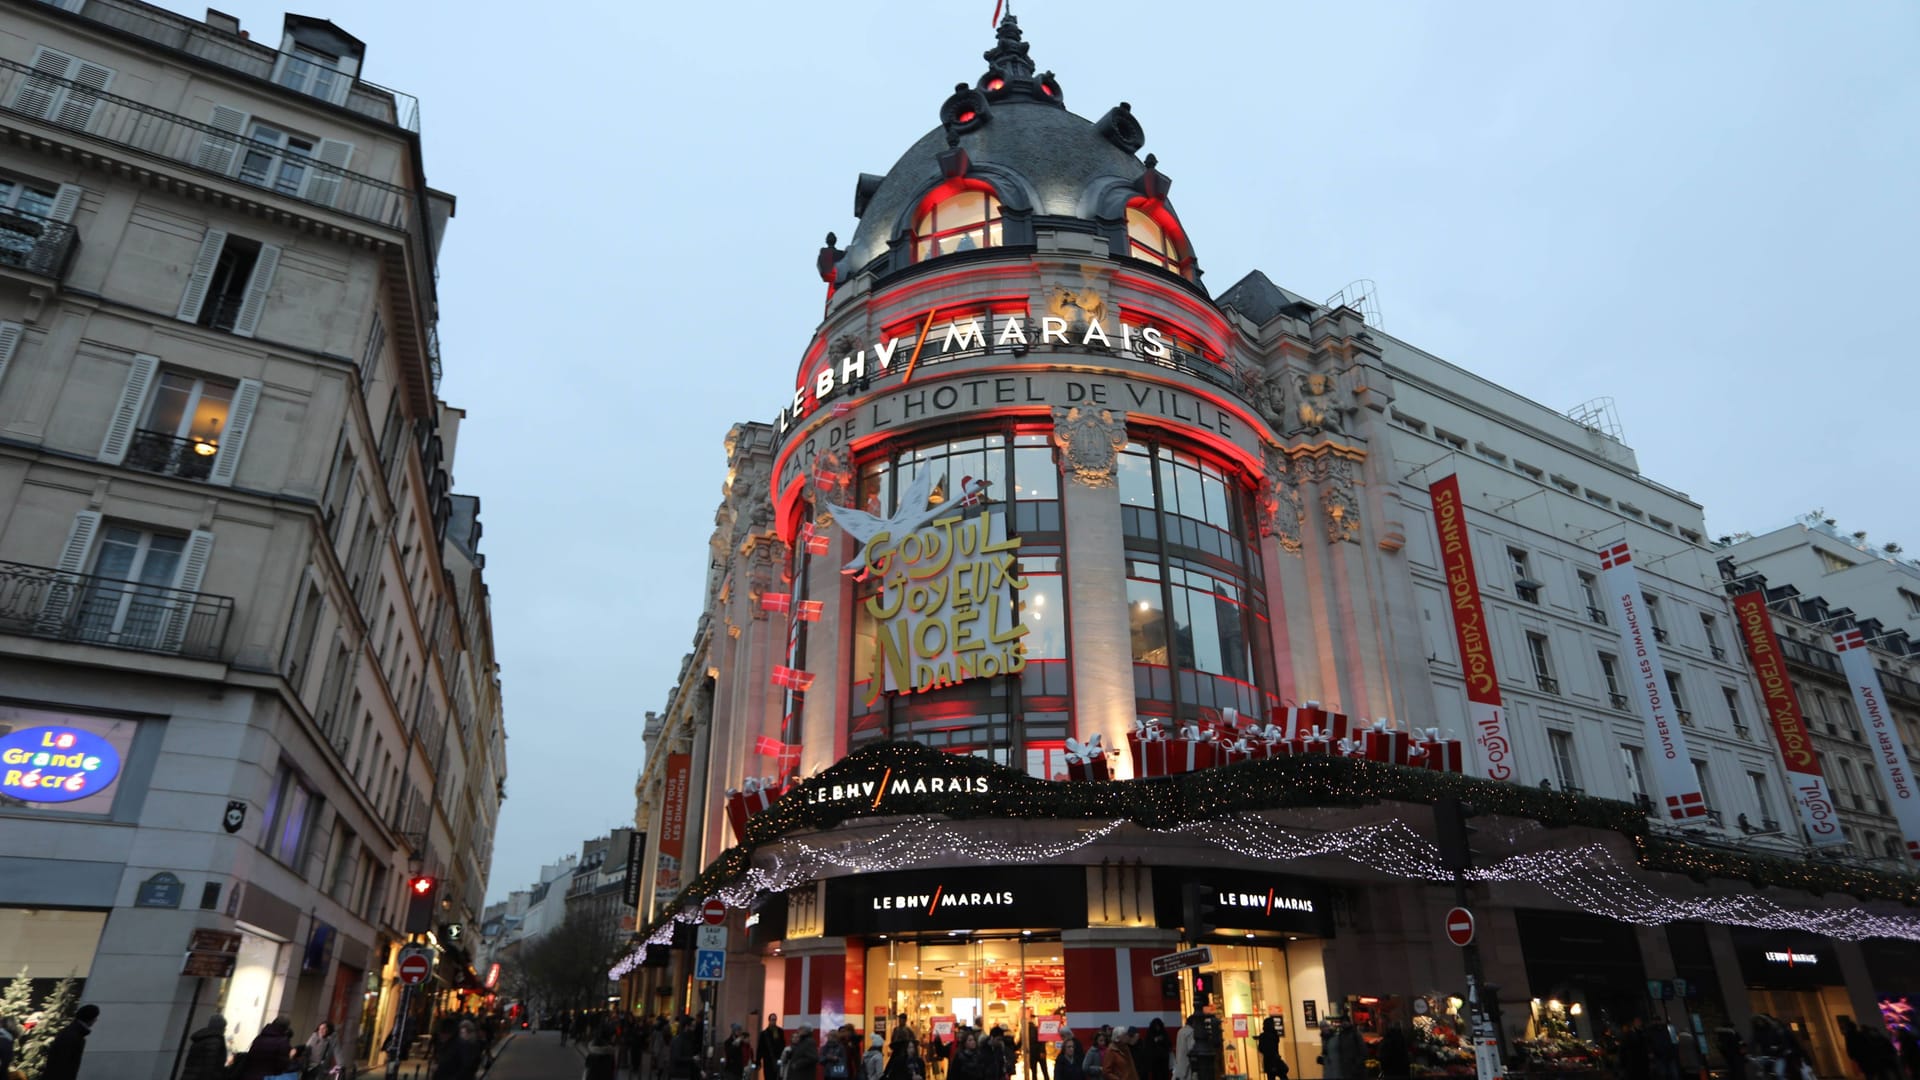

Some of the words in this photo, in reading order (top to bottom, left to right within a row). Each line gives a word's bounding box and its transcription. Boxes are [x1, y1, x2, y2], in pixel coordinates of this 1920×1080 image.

[781, 386, 805, 433] LE
[830, 418, 857, 447] DE
[873, 377, 1045, 428] L'HOTEL
[1067, 382, 1106, 404] DE
[1125, 383, 1231, 438] VILLE
[1621, 594, 1647, 657] DIMANCHES
[1640, 658, 1653, 681] LES
[1646, 681, 1662, 712] TOUS
[1860, 686, 1885, 728] SUNDAY
[41, 731, 77, 749] La
[1654, 715, 1676, 760] OUVERT
[1876, 731, 1898, 765] EVERY
[2, 747, 102, 771] Grande
[3, 768, 86, 792] Récré
[668, 778, 677, 802] TOUS
[1889, 767, 1911, 800] OPEN
[807, 787, 827, 804] LE
[663, 804, 674, 840] OUVERT
[672, 819, 681, 840] LES
[873, 897, 892, 909] LE
[1220, 892, 1237, 905] LE
